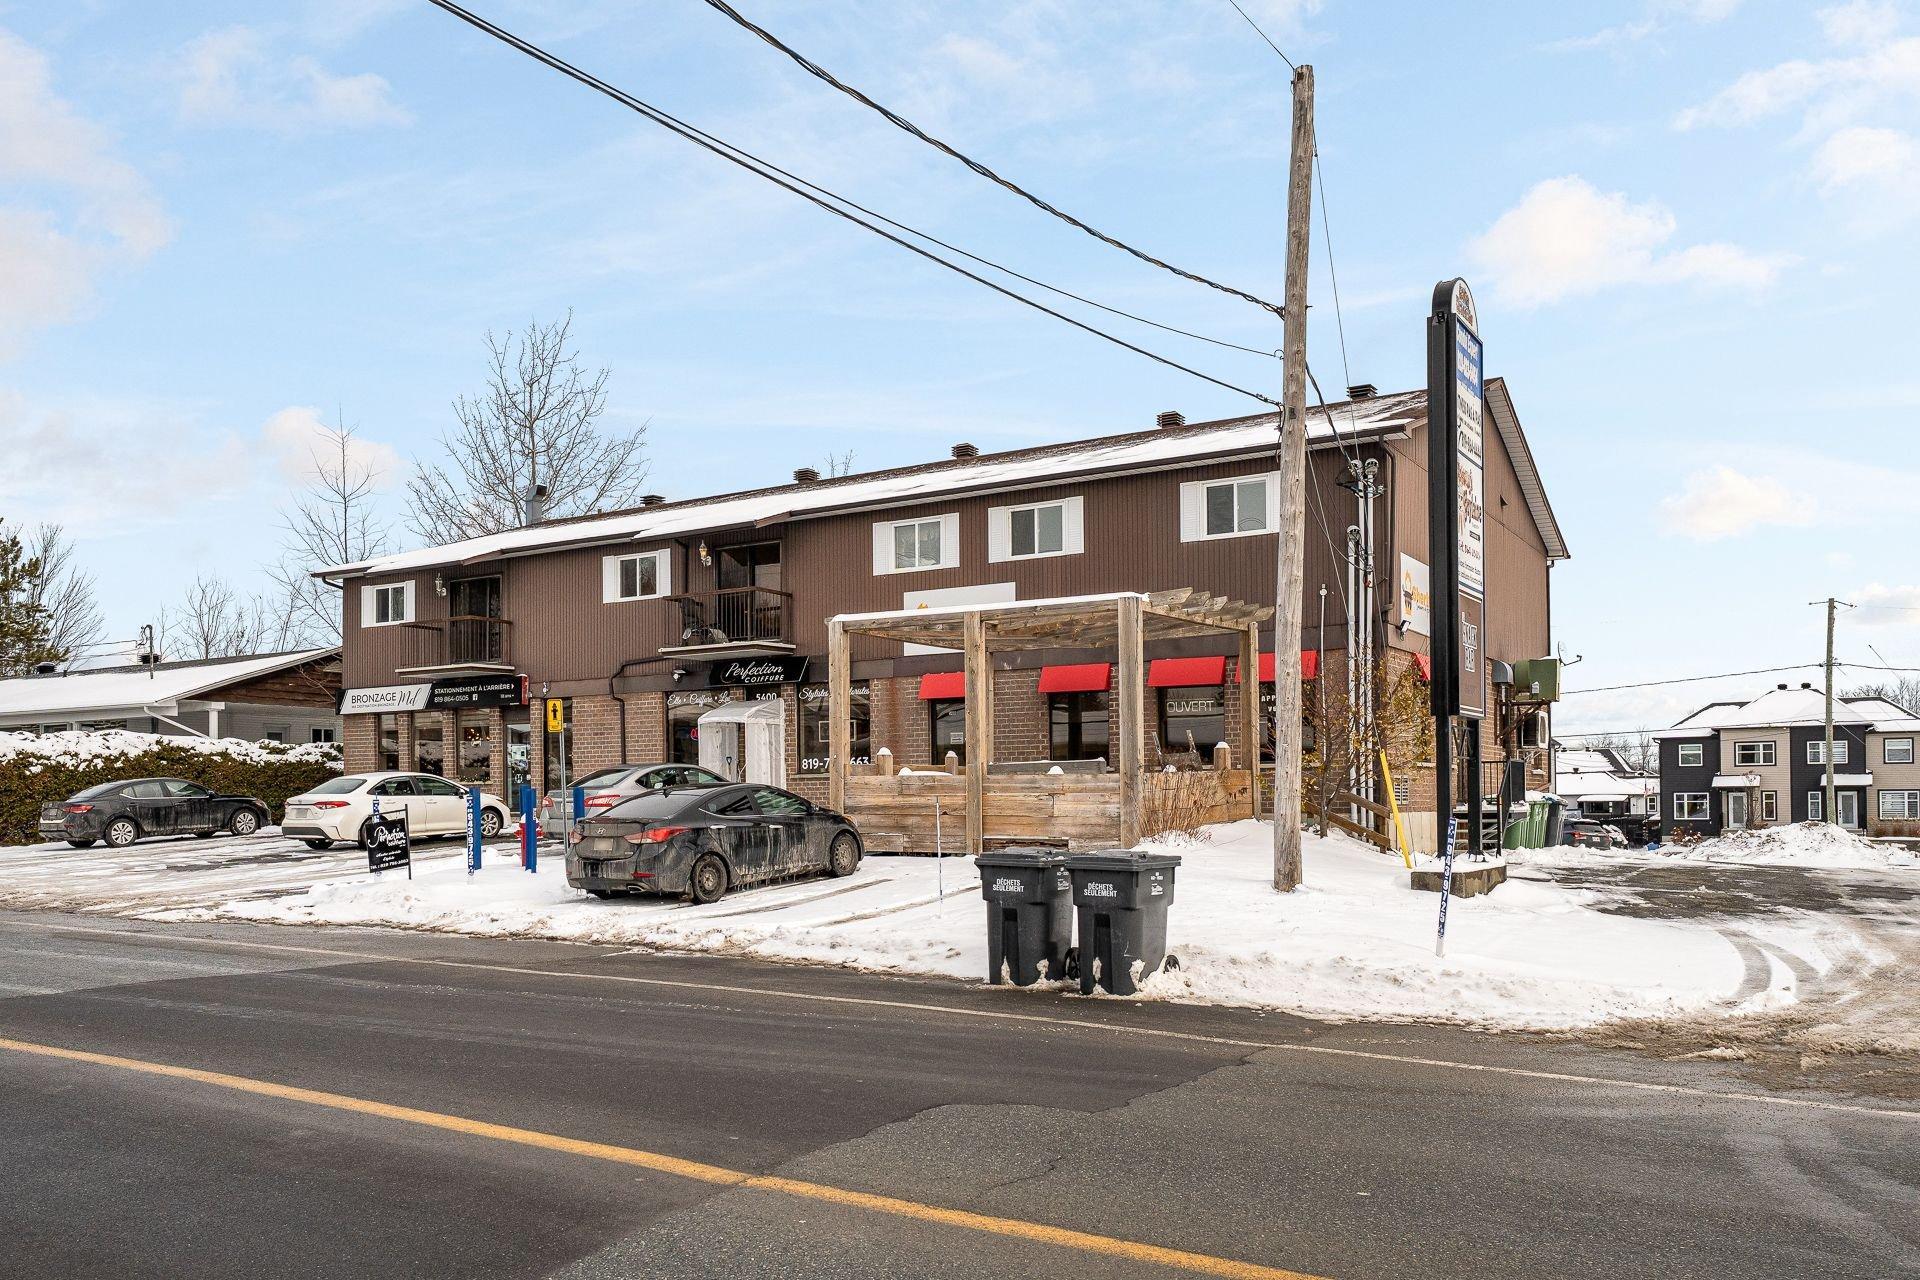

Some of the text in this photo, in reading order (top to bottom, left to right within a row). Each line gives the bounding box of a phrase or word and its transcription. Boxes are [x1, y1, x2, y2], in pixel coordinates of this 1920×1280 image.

[726, 661, 783, 679] Perfection
[744, 675, 784, 683] COIFFURE
[435, 686, 477, 694] STATIONNEMENT
[352, 692, 396, 704] BRONZAGE
[756, 693, 777, 701] 5400
[1166, 700, 1214, 713] OUVERT
[996, 877, 1021, 886] DÉCHETS
[993, 884, 1024, 893] SEULEMENT
[1087, 882, 1113, 891] DÉCHETS
[1084, 889, 1117, 897] SEULEMENT
